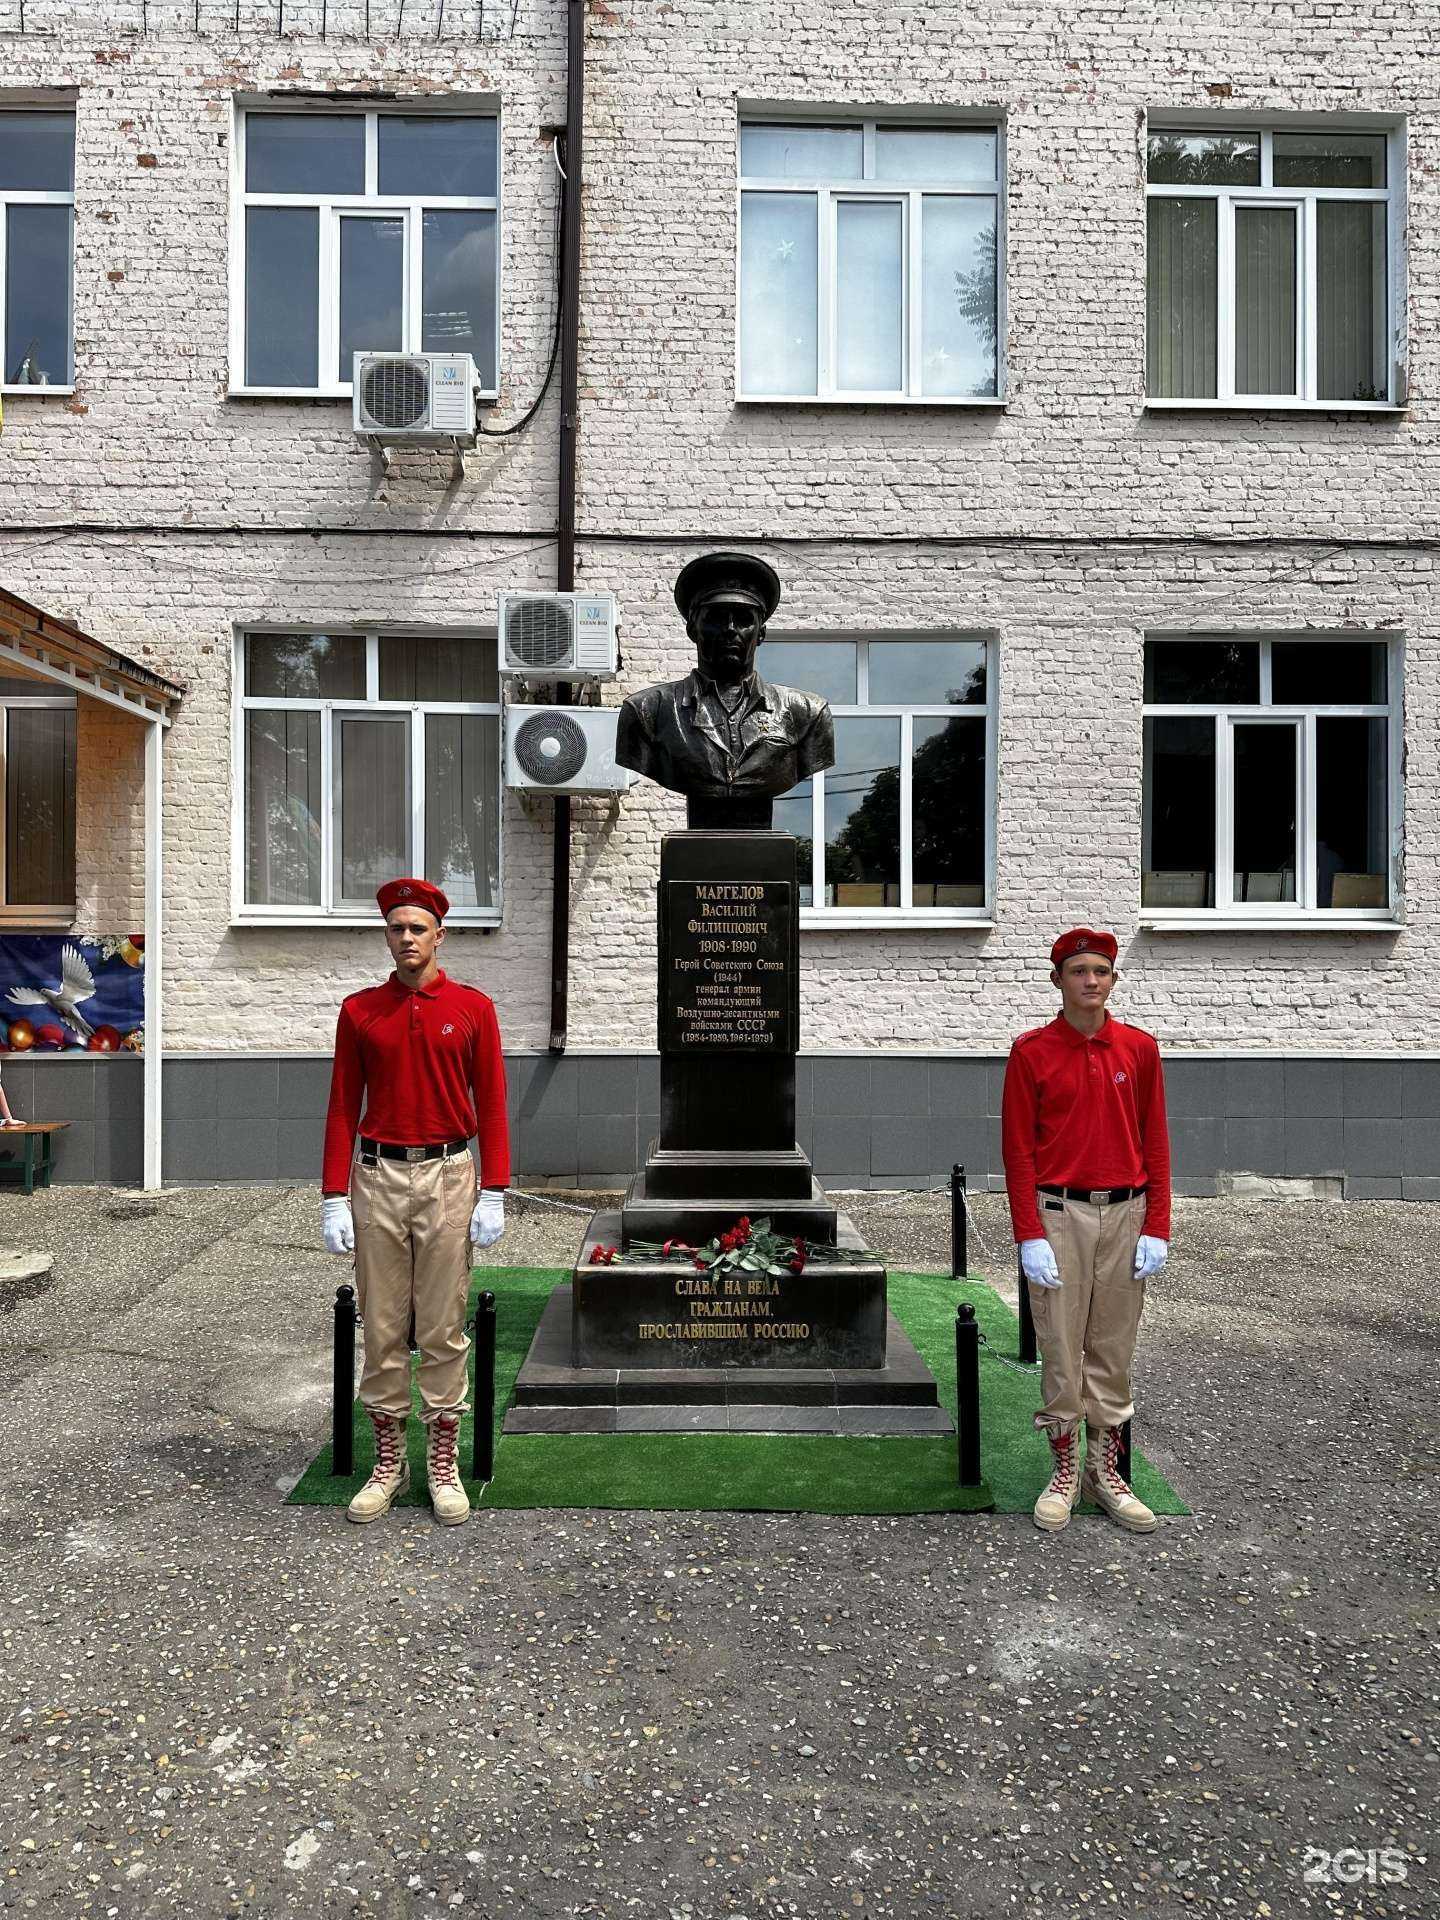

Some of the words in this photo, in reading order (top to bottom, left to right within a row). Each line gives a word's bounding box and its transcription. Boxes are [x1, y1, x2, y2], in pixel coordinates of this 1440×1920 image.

[696, 885, 765, 900] МАРГЕЛОВ
[674, 958, 700, 971] Герой
[703, 958, 752, 970] Советского
[756, 959, 784, 971] Союза
[713, 972, 742, 983] (1944)
[695, 985, 730, 995] генерал
[733, 986, 761, 995] армии
[697, 996, 762, 1008] командующий
[677, 1006, 780, 1020] Воздушно-десантными
[690, 1020, 733, 1030] войсками
[737, 1019, 766, 1031] СССР
[675, 1280, 719, 1296] СЛАВА
[724, 1280, 744, 1296] НА
[639, 1323, 748, 1339] ПРОСЛАВИВШИМ
[754, 1323, 810, 1339] РОССИЮ
